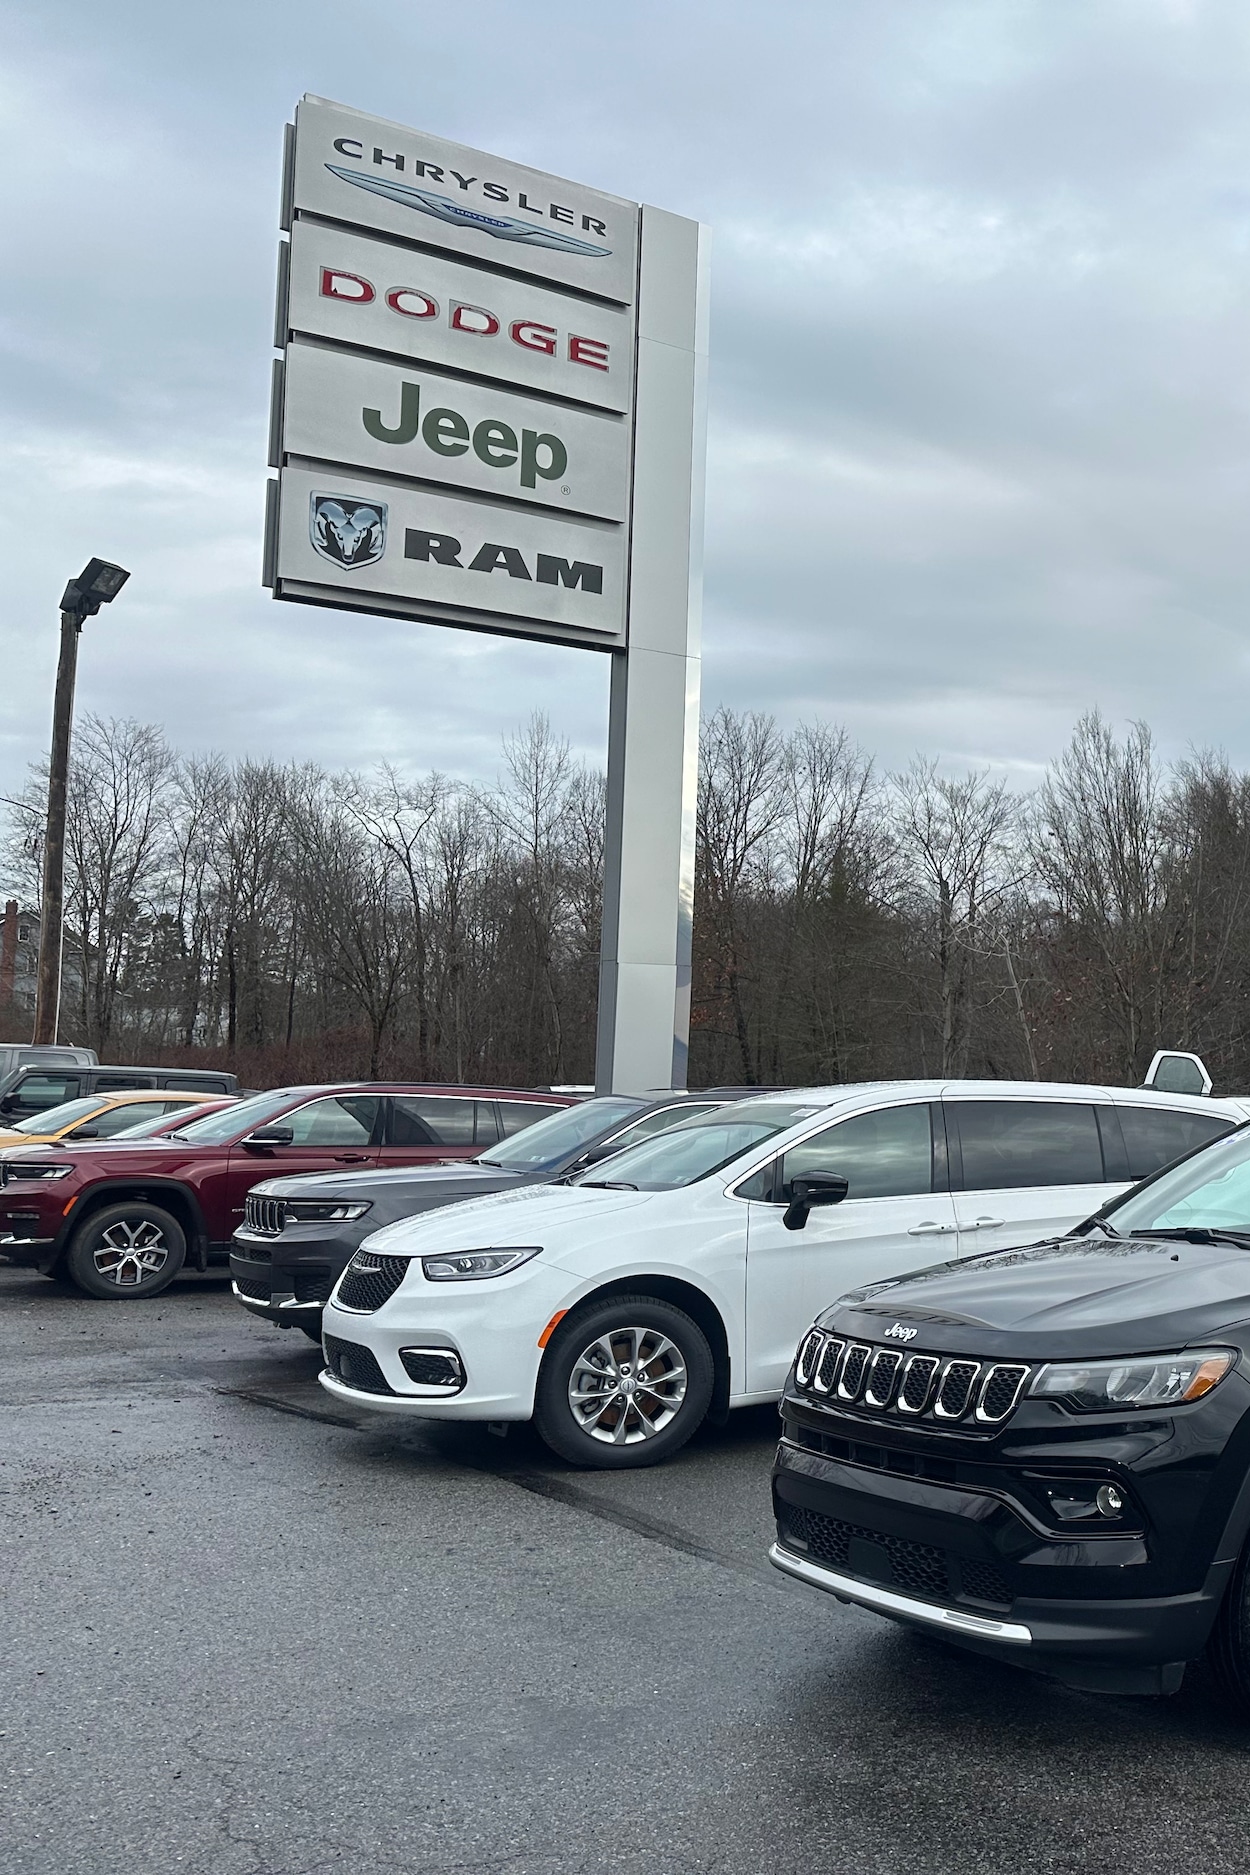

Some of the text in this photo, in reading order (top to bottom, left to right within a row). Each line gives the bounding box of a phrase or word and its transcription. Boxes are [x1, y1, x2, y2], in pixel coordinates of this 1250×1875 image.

[333, 137, 608, 238] CHRYSLER
[320, 266, 610, 372] DODGE
[362, 381, 568, 489] Jeep
[404, 527, 604, 595] RAM
[884, 1322, 918, 1343] Jeep
